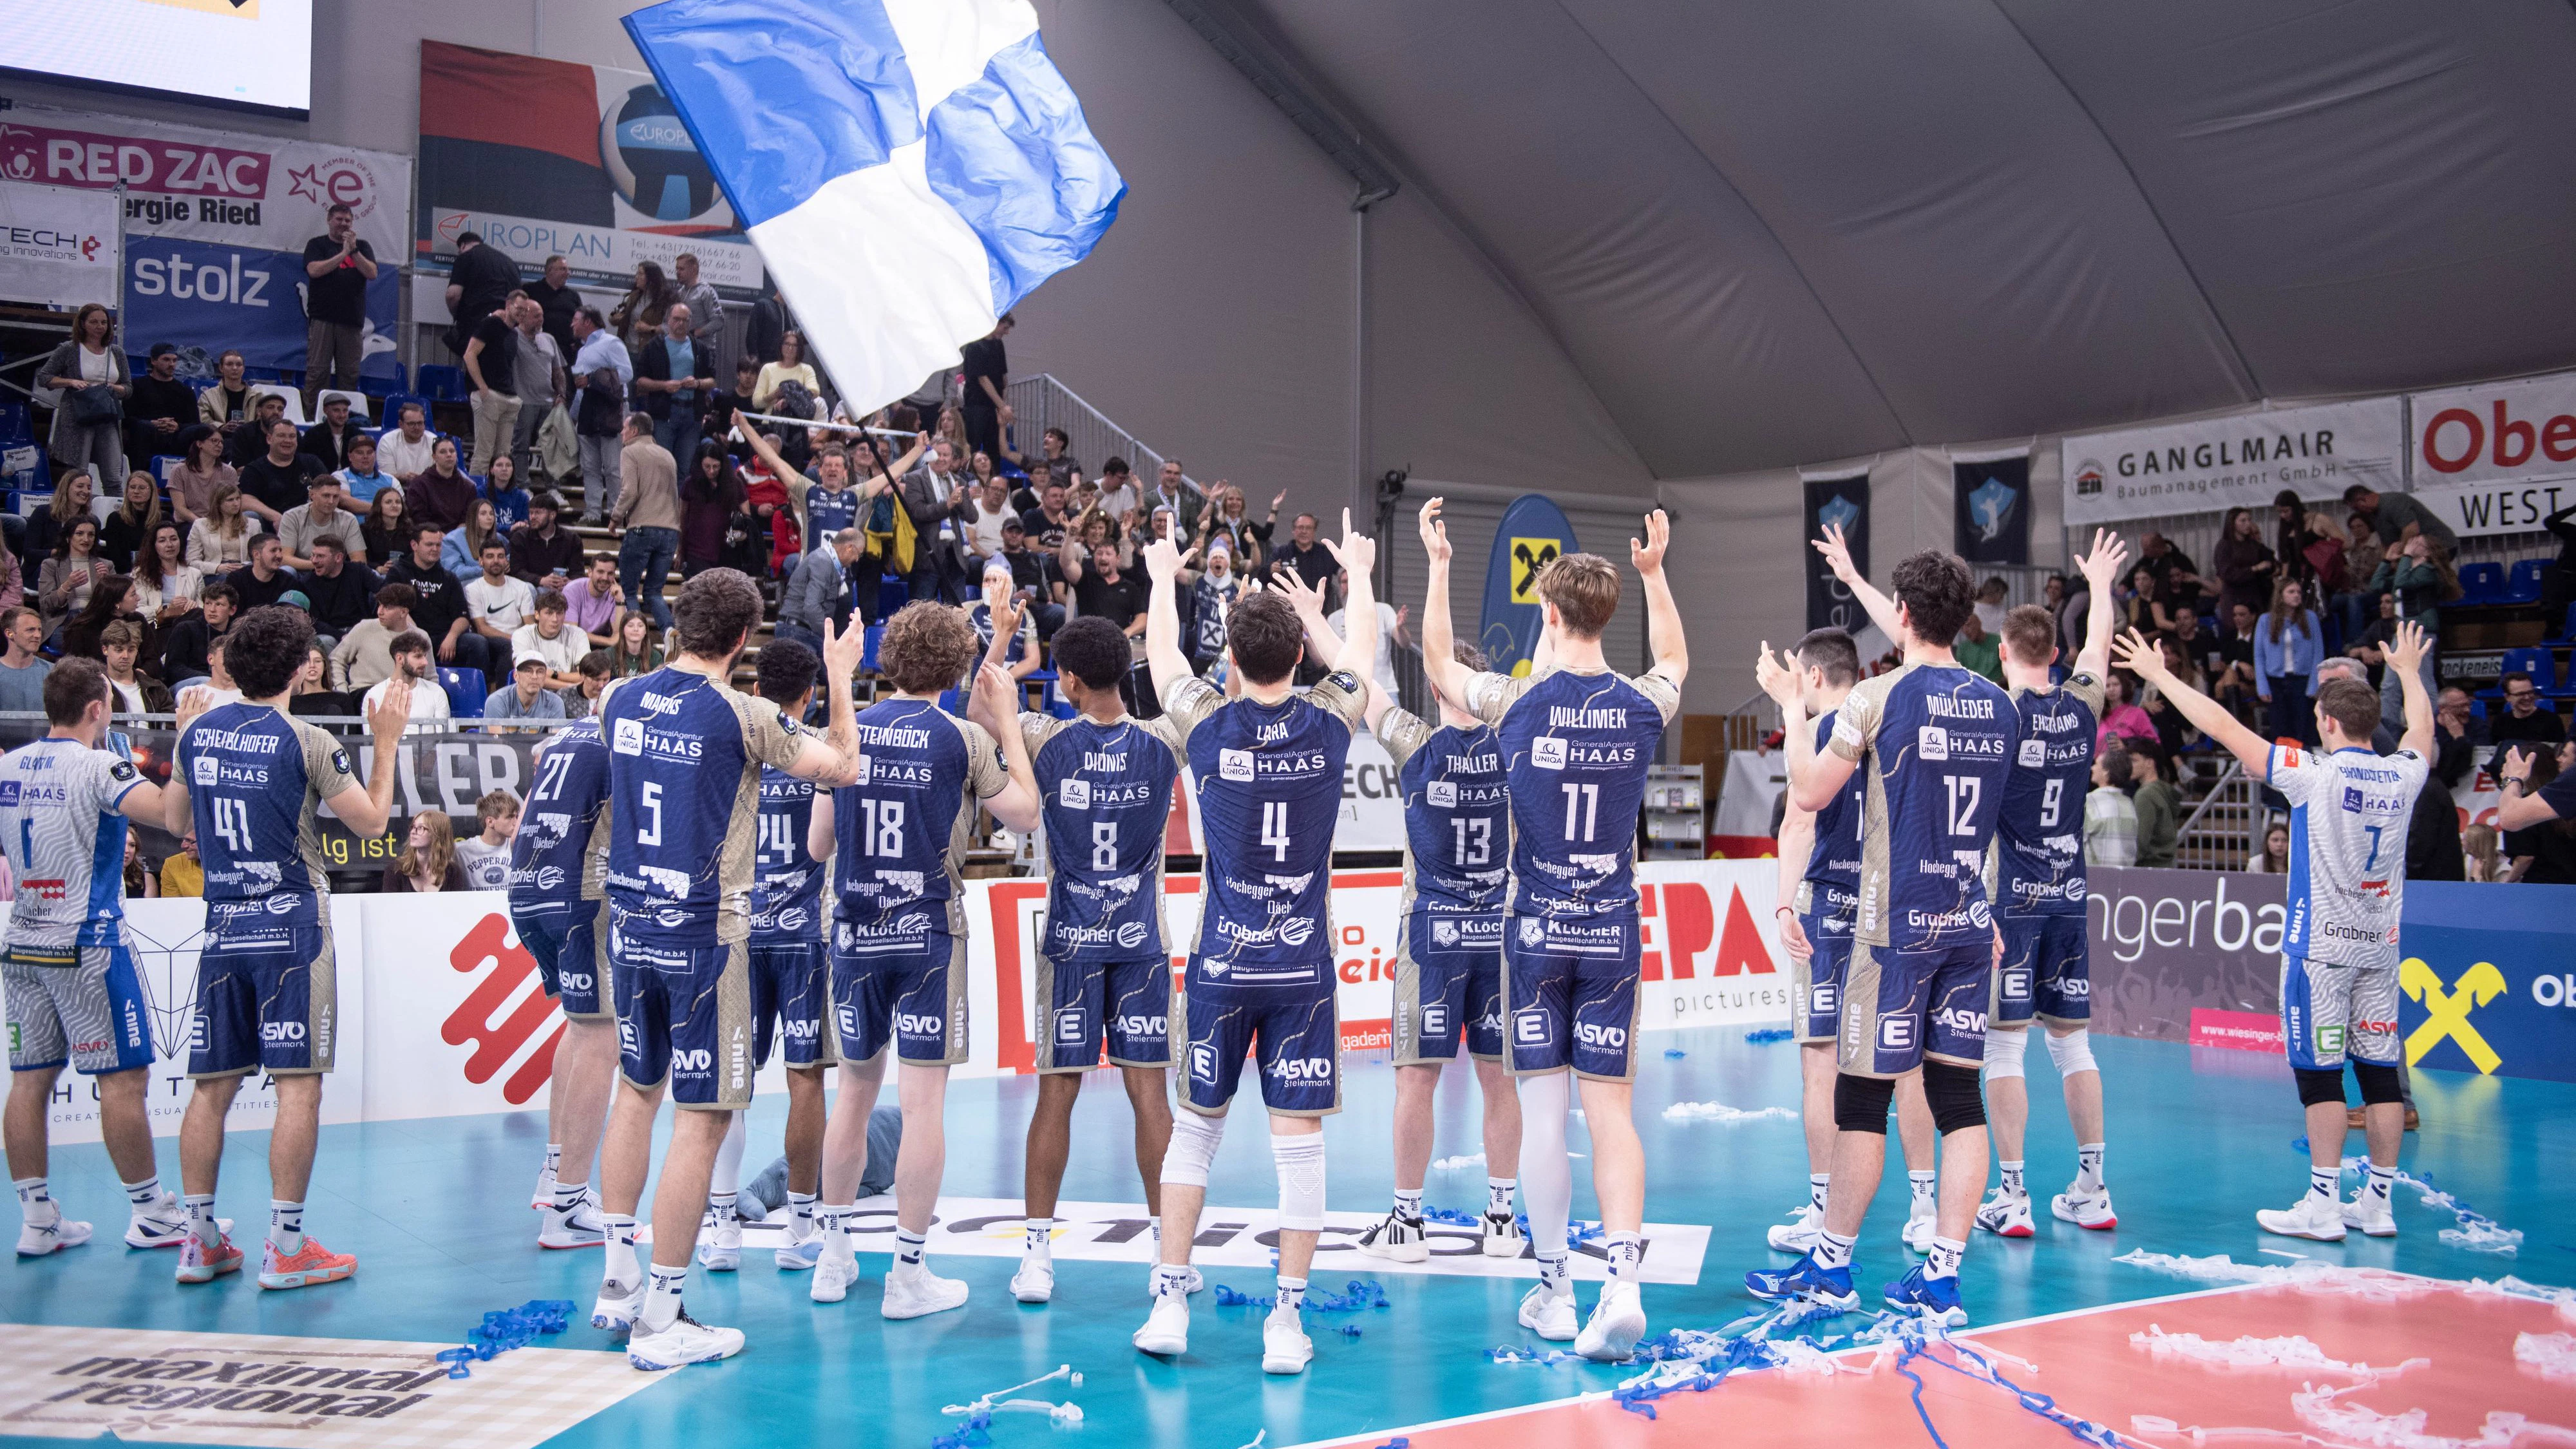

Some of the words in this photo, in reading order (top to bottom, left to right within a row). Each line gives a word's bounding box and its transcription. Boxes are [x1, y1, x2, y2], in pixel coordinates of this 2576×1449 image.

[47, 140, 153, 184] RED
[165, 149, 260, 195] ZAC
[199, 198, 261, 225] Ried
[14, 246, 77, 260] innovations
[134, 255, 269, 307] stolz
[2117, 431, 2334, 477] GANGLMAIR
[2117, 471, 2268, 498] Baumanagement
[2280, 463, 2336, 481] GmbH
[2460, 488, 2561, 528] WEST
[411, 579, 442, 590] TOMMY
[639, 691, 683, 715] MARKS
[1926, 693, 1994, 719] MÜLLEDER
[1549, 706, 1627, 729] WILLIMEK
[2032, 712, 2078, 734] EHSTRAND
[193, 728, 279, 753] SCHEIBLHOFER
[647, 726, 704, 741] GeneralAgentur
[858, 725, 931, 748] STEINBÖCK
[1257, 722, 1289, 741] LARA
[1949, 730, 2005, 739] GeneralAgentur
[615, 739, 639, 750] UNIQA
[645, 734, 703, 757] HAAS
[1257, 748, 1323, 759] GeneralAgentur
[1569, 748, 1636, 762] HAAS
[1571, 740, 1636, 749] GeneralAgentur
[1922, 746, 1946, 755] UNIQA
[1949, 739, 2004, 754] HAAS
[2047, 743, 2087, 760] HAAS
[875, 757, 933, 768] GeneralAgentur
[1084, 752, 1128, 772] DIONIS
[1258, 755, 1325, 773] HAAS
[1446, 753, 1498, 773] THALLER
[1535, 754, 1562, 764] UNIQA
[220, 766, 269, 782] HAAS
[535, 753, 575, 800] 21
[873, 764, 932, 782] HAAS
[1222, 767, 1251, 776] UNIQA
[23, 788, 65, 800] HAAS
[1093, 786, 1150, 802] HAAS
[1094, 779, 1150, 790] GeneralAgentur
[1063, 795, 1087, 805] UNIQA
[1430, 795, 1454, 804] UNIQA
[1944, 775, 1981, 835] 12
[2040, 779, 2063, 826] 9
[637, 781, 663, 846] 5
[1562, 782, 1598, 842] 11
[214, 797, 252, 852] 41
[861, 799, 904, 858] 18
[1260, 802, 1290, 862] 4
[361, 833, 397, 857] ist
[533, 837, 555, 849] Dächer
[757, 814, 796, 864] 24
[1093, 822, 1117, 871] 8
[1451, 817, 1492, 865] 13
[2364, 825, 2382, 871] 7
[208, 871, 244, 885] Hochegger
[1533, 855, 1578, 879] Hochegger
[243, 880, 274, 895] Dächer
[1226, 876, 1274, 899] Hochegger
[2012, 877, 2065, 897] Grabner
[879, 896, 911, 908] Dächer
[1865, 887, 1877, 931] nine
[1217, 916, 1280, 942] Grabner
[1909, 909, 1969, 927] Grabner
[2289, 909, 2304, 943] nine
[220, 933, 266, 942] Baugesellschaft
[1056, 922, 1116, 942] Grabner
[1546, 934, 1597, 944] Baugesellschaft
[2324, 922, 2382, 943] Grabner
[11, 947, 53, 956] Baugesellschaft
[2005, 974, 2026, 996] E
[1675, 989, 1786, 1018] pictures
[1795, 983, 1806, 1016] nine
[896, 1012, 941, 1033] ASVÖ
[954, 1010, 965, 1048] nine
[1060, 1014, 1081, 1039] E
[1117, 1016, 1168, 1034] ASVÖ
[1399, 1001, 1408, 1037] nine
[1425, 1010, 1445, 1032] E
[1517, 1015, 1545, 1041] E
[1848, 1003, 1861, 1044] nine
[2291, 1006, 2300, 1039] nine
[318, 1025, 330, 1057] nine
[900, 1032, 940, 1041] Steiermark
[1574, 1021, 1626, 1046] ASVÖ
[1884, 1020, 1911, 1045] E
[1580, 1042, 1624, 1056] Steiermark
[732, 1046, 745, 1089] nine
[1194, 1048, 1211, 1077] E
[1273, 1057, 1331, 1078] ASVÖ
[1284, 1078, 1331, 1088] Steiermark
[1946, 1249, 1955, 1267] nine
[656, 1275, 668, 1291] nine
[1282, 1287, 1290, 1304] nine
[50, 1356, 451, 1392] maximal
[43, 1381, 433, 1418] regional
